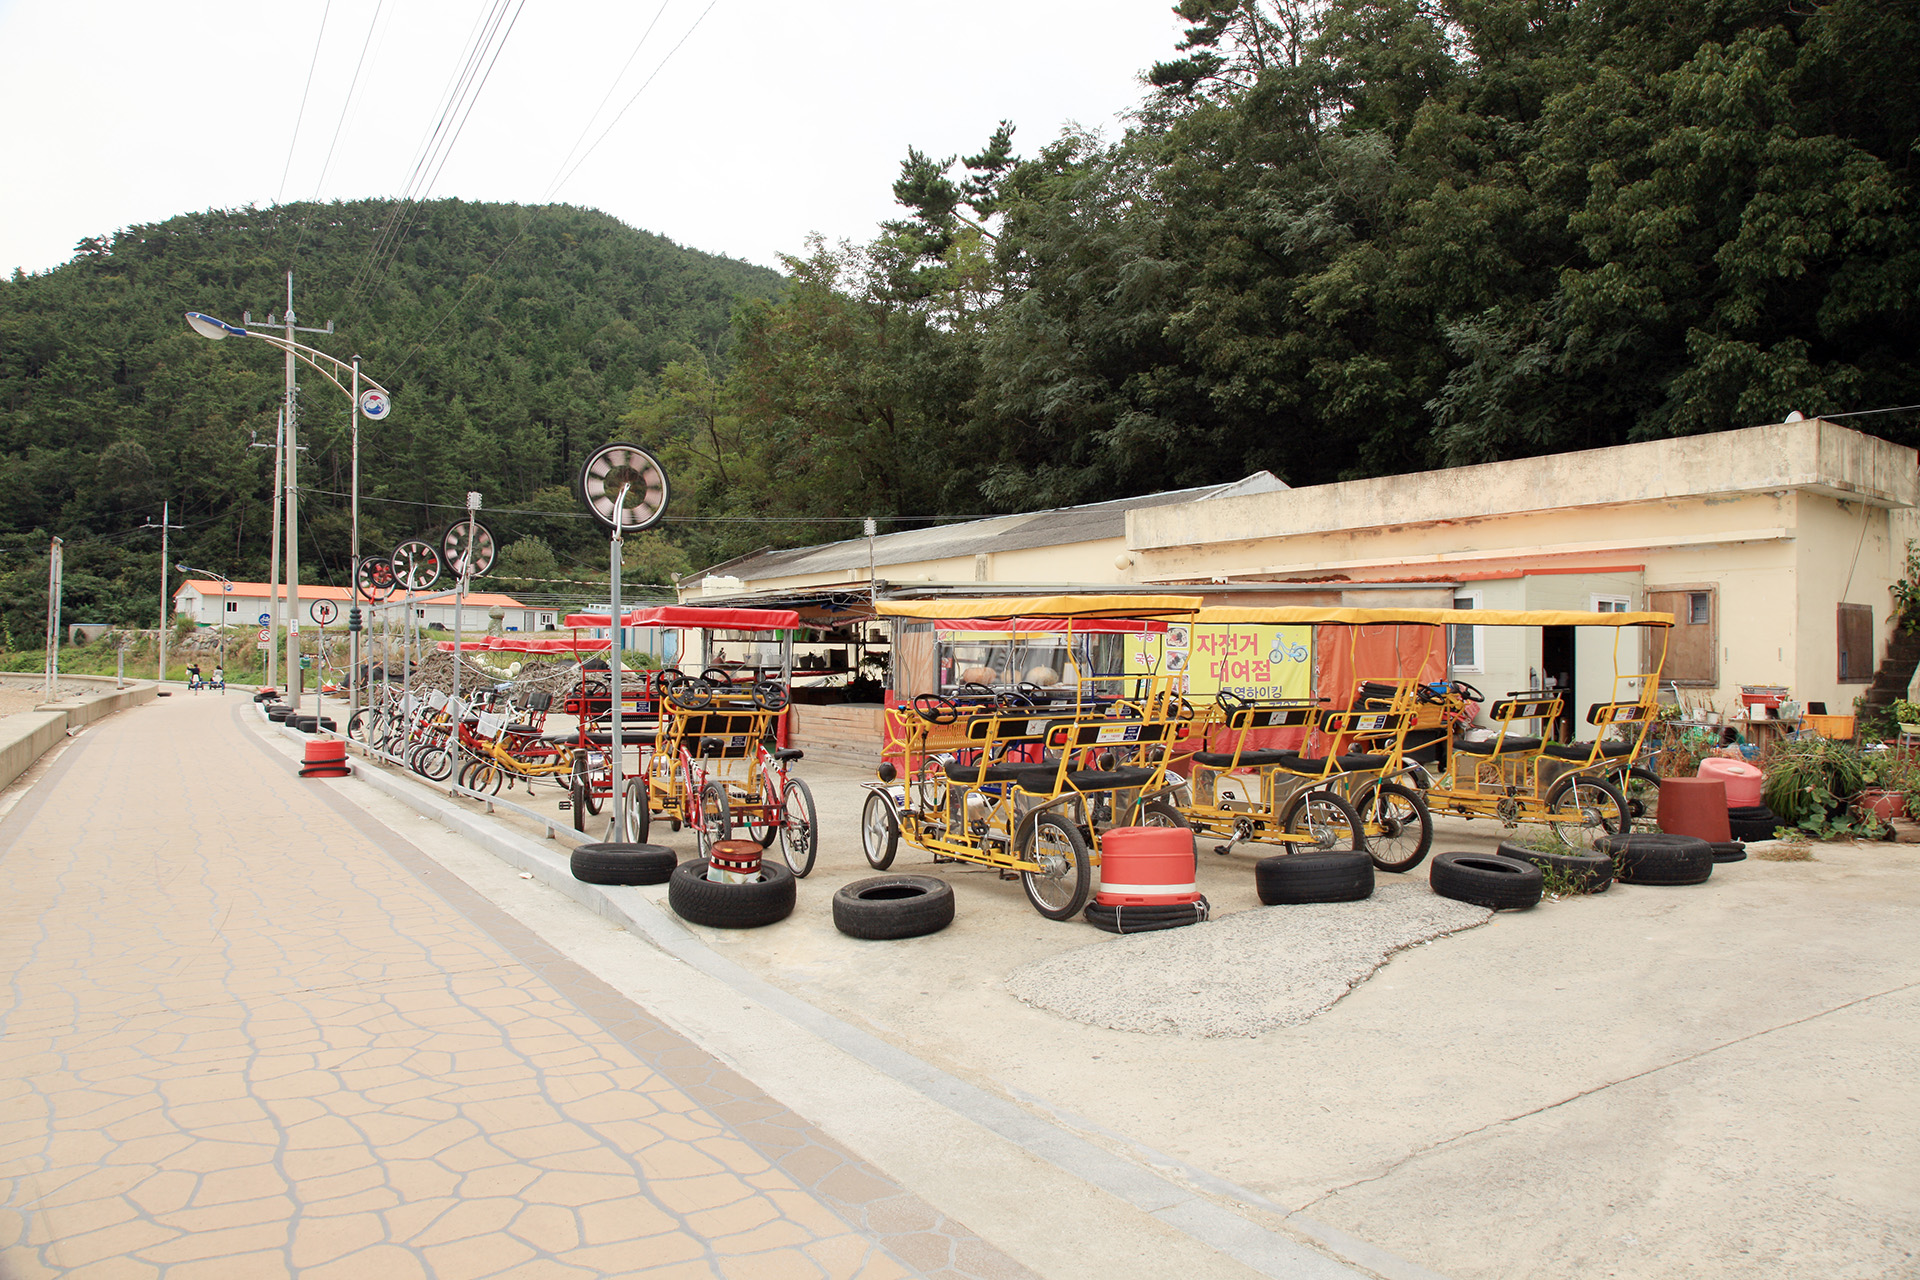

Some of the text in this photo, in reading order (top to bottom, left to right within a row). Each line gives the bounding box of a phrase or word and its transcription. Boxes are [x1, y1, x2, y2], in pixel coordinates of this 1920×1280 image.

[1196, 633, 1258, 656] 자전거
[1135, 653, 1155, 665] 국수
[1210, 659, 1271, 683] 대여점
[1222, 685, 1283, 700] 통영하이킹
